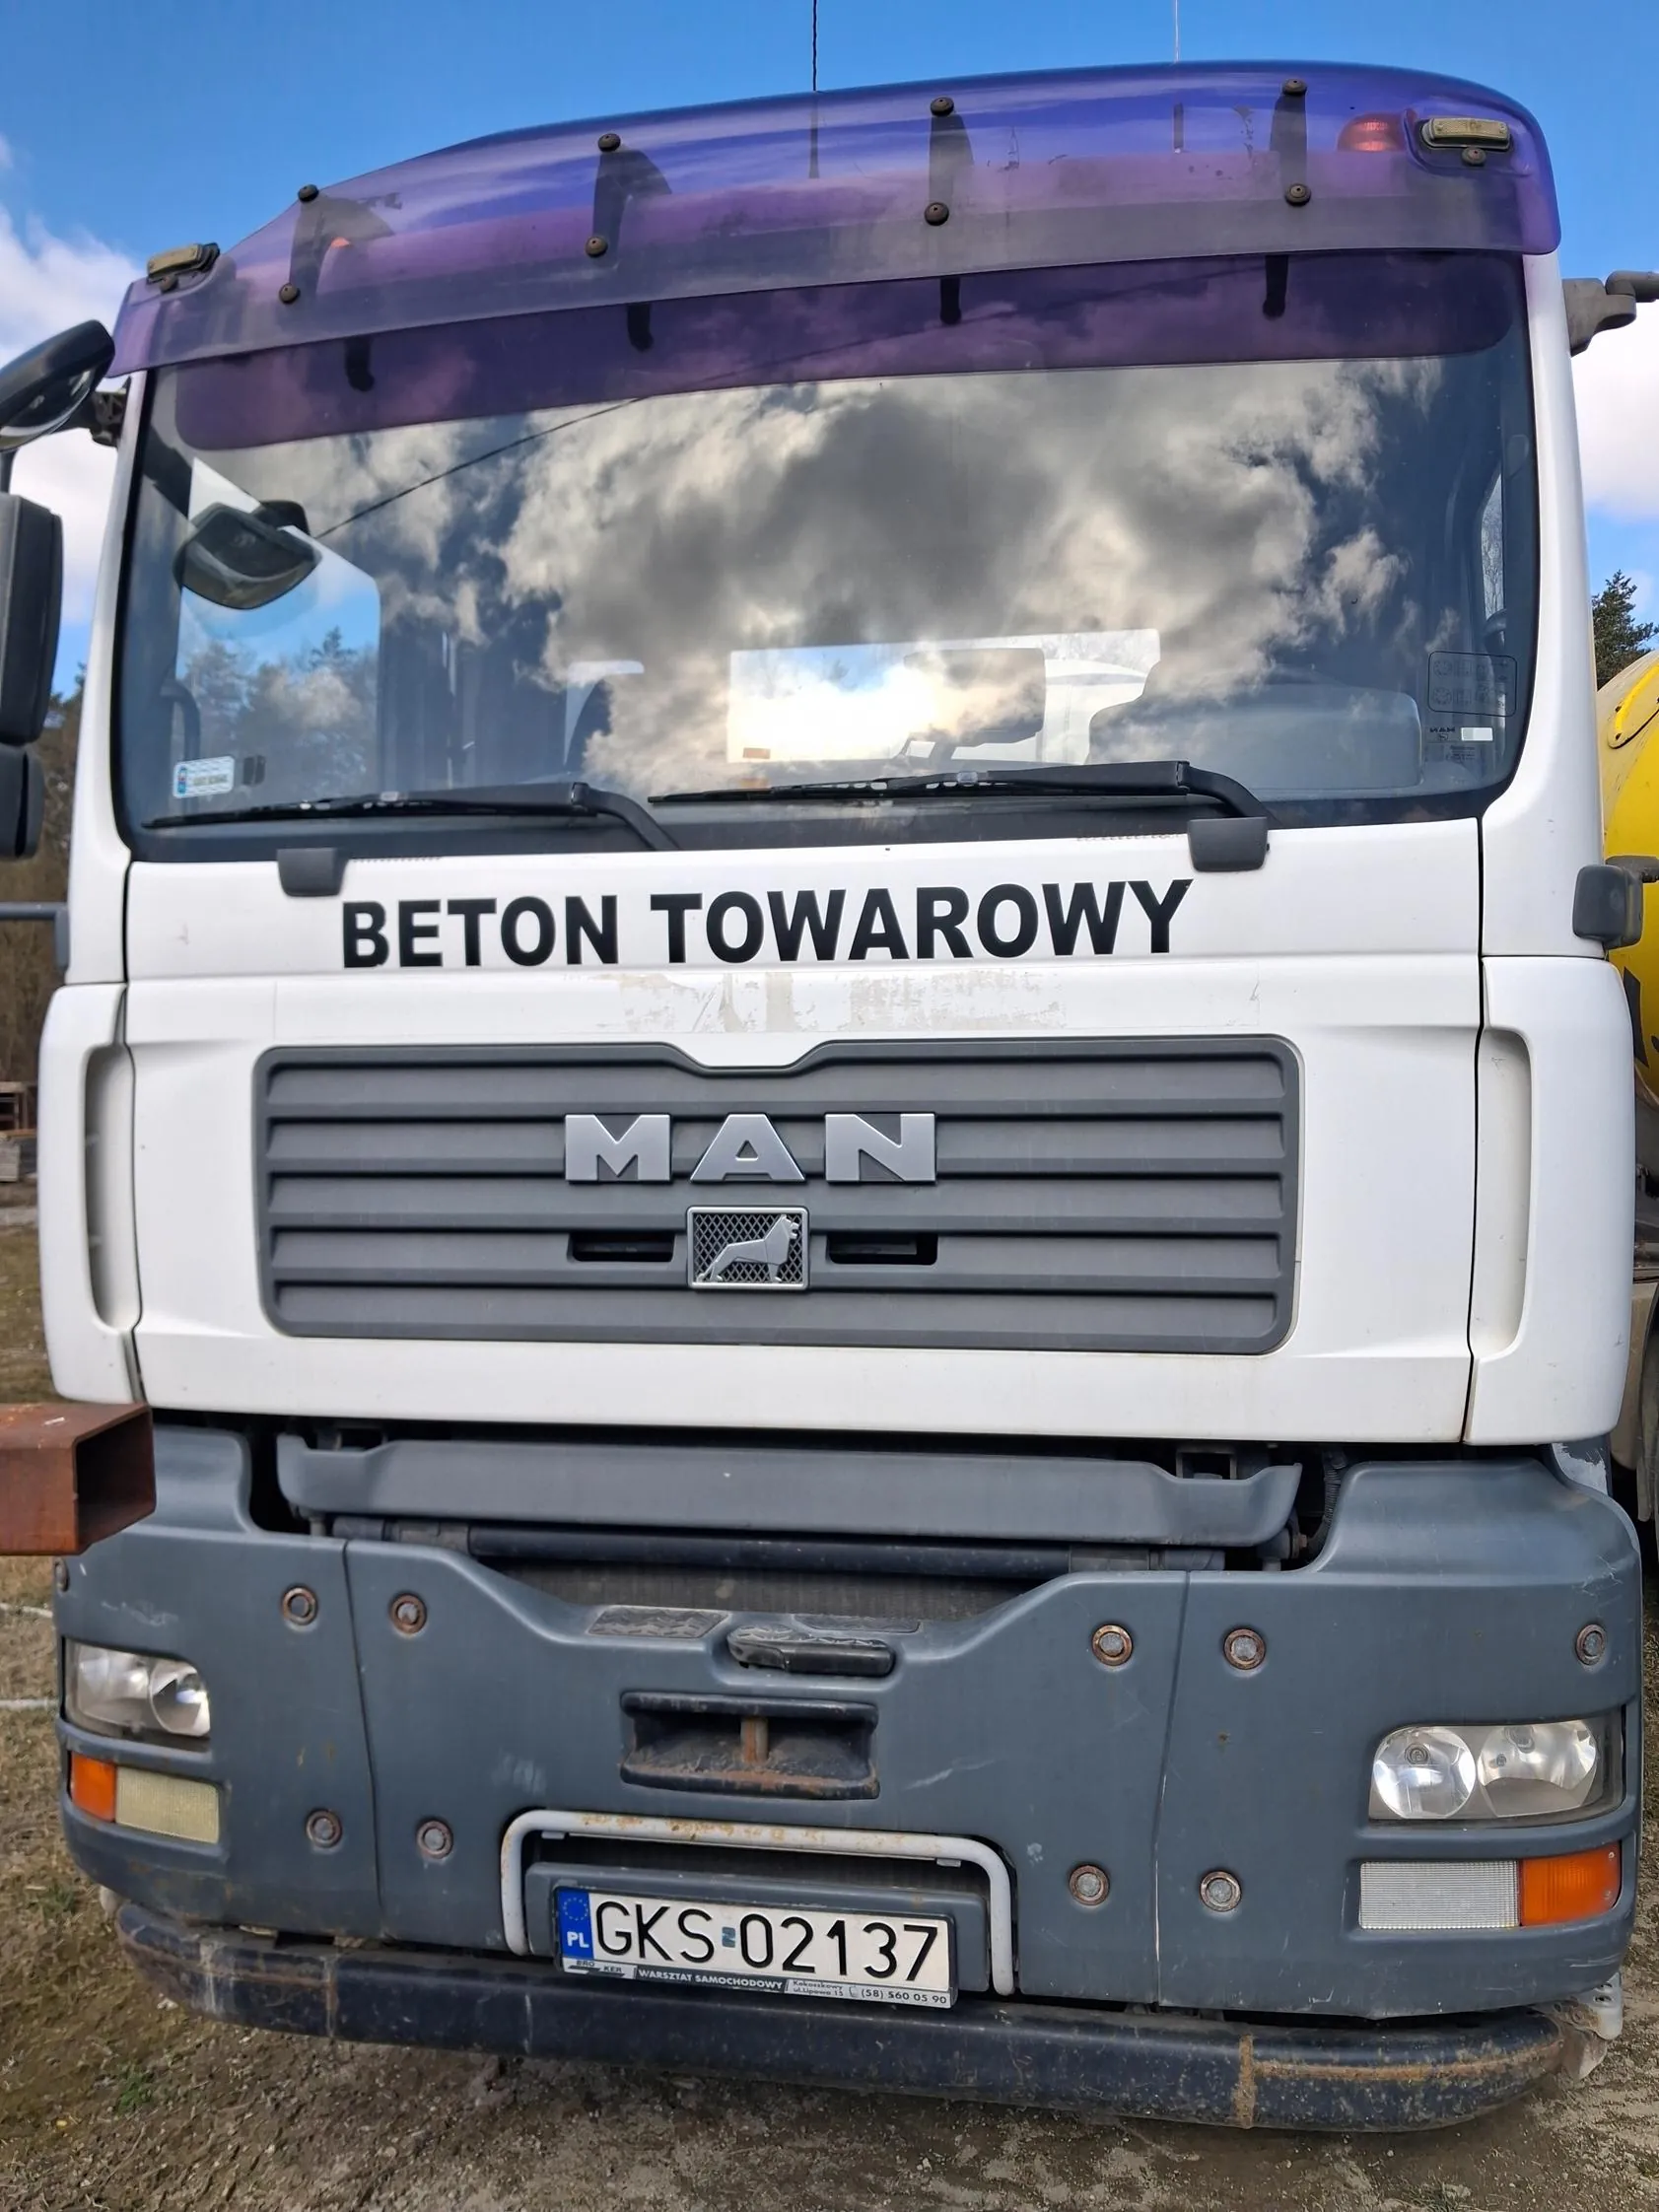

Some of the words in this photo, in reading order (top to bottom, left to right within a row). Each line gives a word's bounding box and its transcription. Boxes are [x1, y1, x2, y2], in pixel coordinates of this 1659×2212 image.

[342, 894, 618, 968] BETON
[650, 878, 1194, 964] TOWAROWY
[565, 1113, 935, 1182] MAN
[567, 1931, 589, 1948] PL
[595, 1901, 715, 1964] GKS
[739, 1913, 938, 1981] 02137
[639, 1970, 692, 1981] WARSZTAT
[695, 1974, 783, 1989] SAMOCHODOWY
[861, 1989, 884, 2000] (58)
[888, 1990, 910, 2001] 560
[913, 1993, 929, 2002] 05
[932, 1995, 947, 2004] 90
